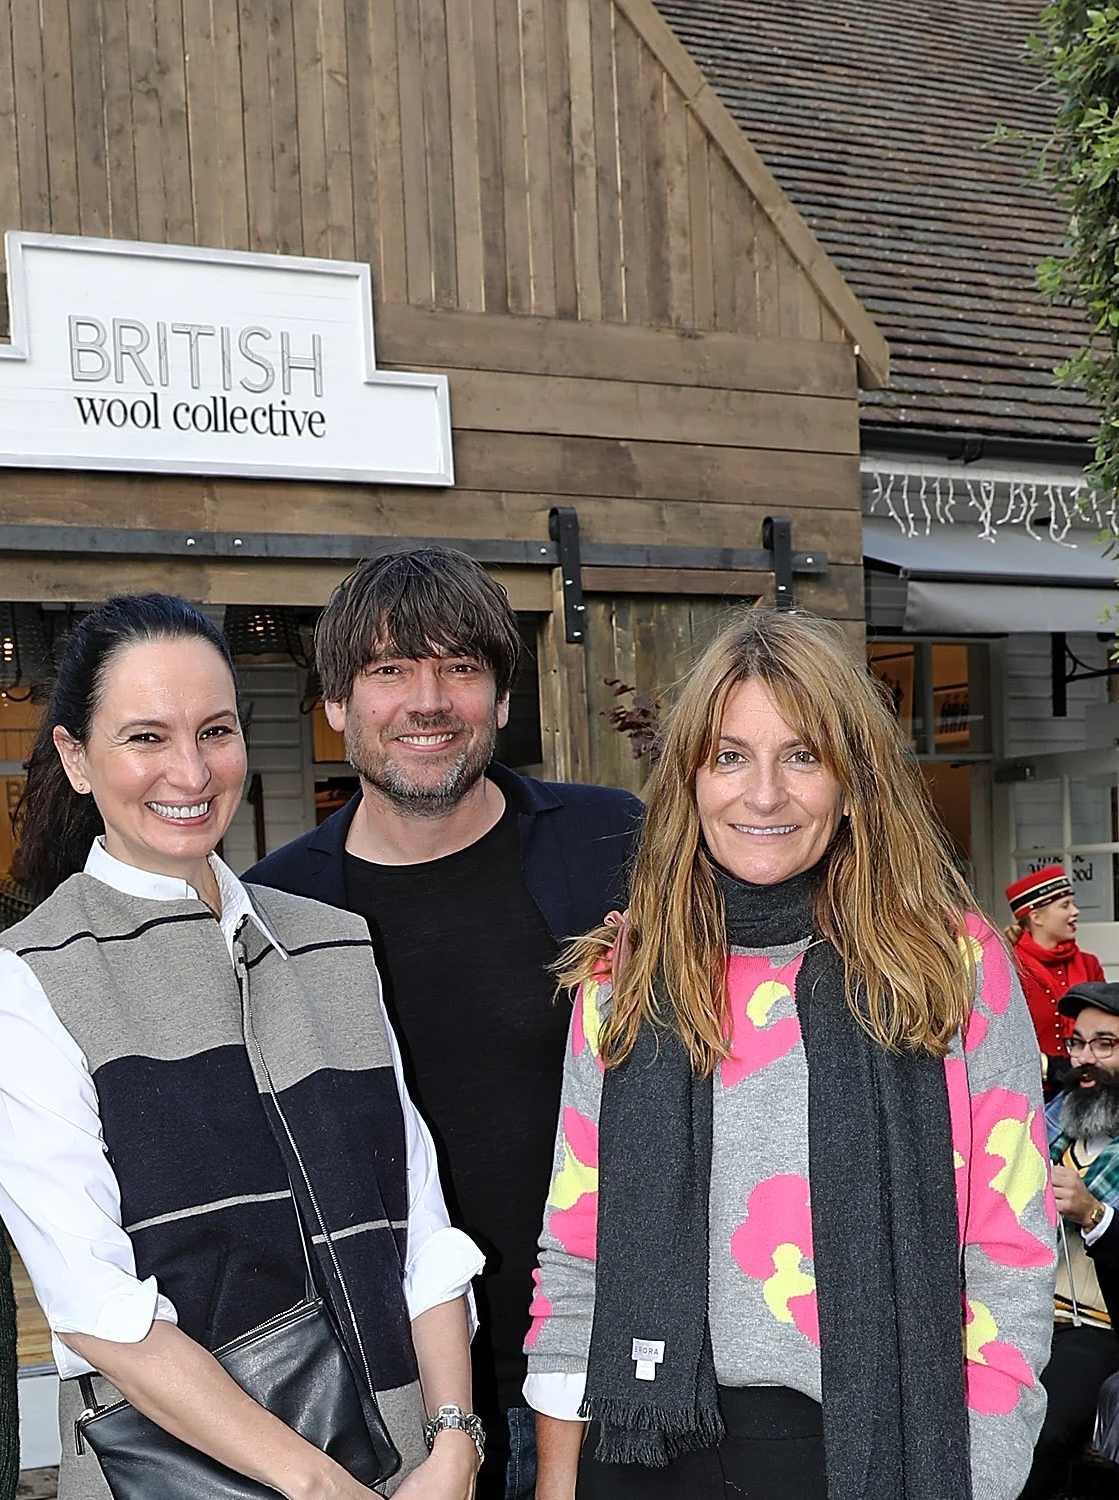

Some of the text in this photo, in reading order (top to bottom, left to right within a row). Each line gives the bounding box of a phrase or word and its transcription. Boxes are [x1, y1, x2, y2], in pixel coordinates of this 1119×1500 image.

[68, 314, 323, 397] BRITISH
[74, 392, 327, 438] wool collective
